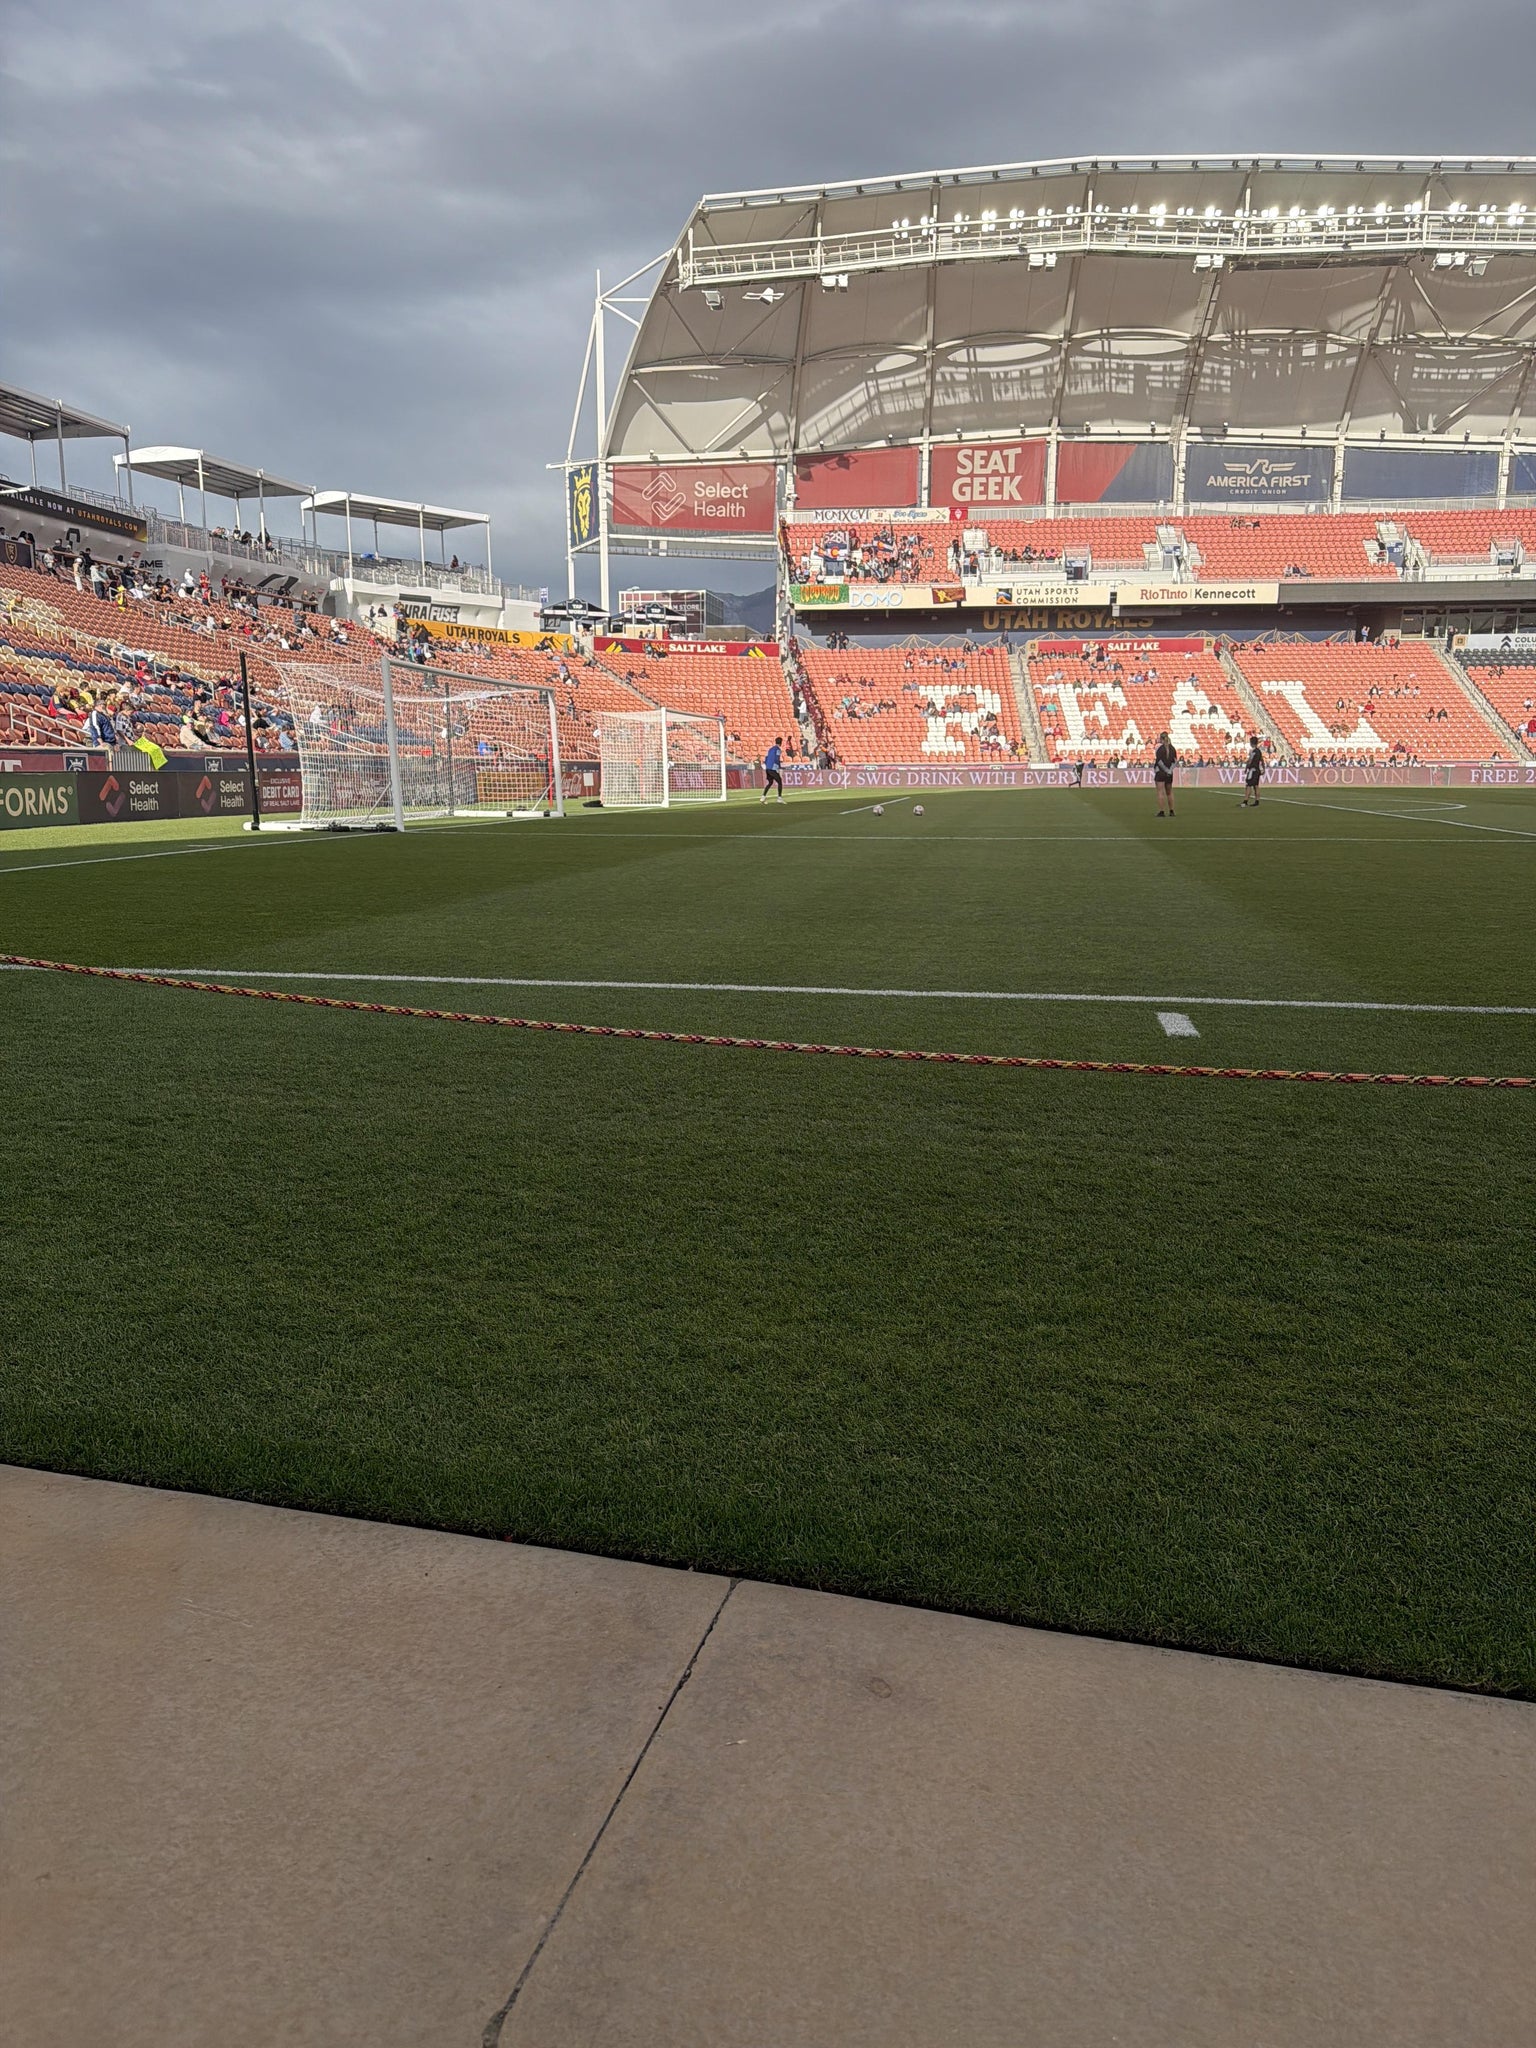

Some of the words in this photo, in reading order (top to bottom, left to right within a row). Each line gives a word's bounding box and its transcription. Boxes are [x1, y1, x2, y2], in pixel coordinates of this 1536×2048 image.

[956, 447, 1022, 475] SEAT
[1206, 475, 1269, 487] AMERICA
[1270, 474, 1312, 487] FIRST
[694, 481, 749, 498] Select
[952, 475, 1023, 502] GEEK
[4, 491, 44, 507] AILABLE
[47, 501, 63, 512] NOW
[66, 506, 75, 515] AT
[694, 501, 746, 518] Health
[1045, 587, 1079, 595] SPORTS
[1194, 588, 1256, 600] Kennecott
[404, 604, 428, 620] URA
[430, 605, 459, 623] FUSE
[982, 609, 1049, 629] UTAH
[446, 624, 476, 640] UTAH
[479, 627, 521, 644] ROYALS
[669, 643, 696, 652] SALT
[697, 644, 727, 653] LAKE
[1107, 642, 1133, 651] SALT
[1133, 641, 1160, 651] LAKE
[806, 771, 824, 785] 24
[829, 771, 851, 785] OZ
[856, 771, 900, 785] SWIG
[907, 771, 963, 785] DRINK
[969, 771, 1017, 785] WITH
[1087, 770, 1120, 784] RSL
[1312, 769, 1355, 784] YOU
[1362, 768, 1411, 784] WIN!
[1470, 769, 1519, 783] FREE
[1525, 769, 1536, 783] 2
[129, 780, 159, 795] Select
[220, 779, 245, 793] Select
[262, 786, 281, 798] DEBIT
[282, 786, 300, 798] CARD
[130, 797, 160, 812] Health
[220, 796, 245, 808] Health
